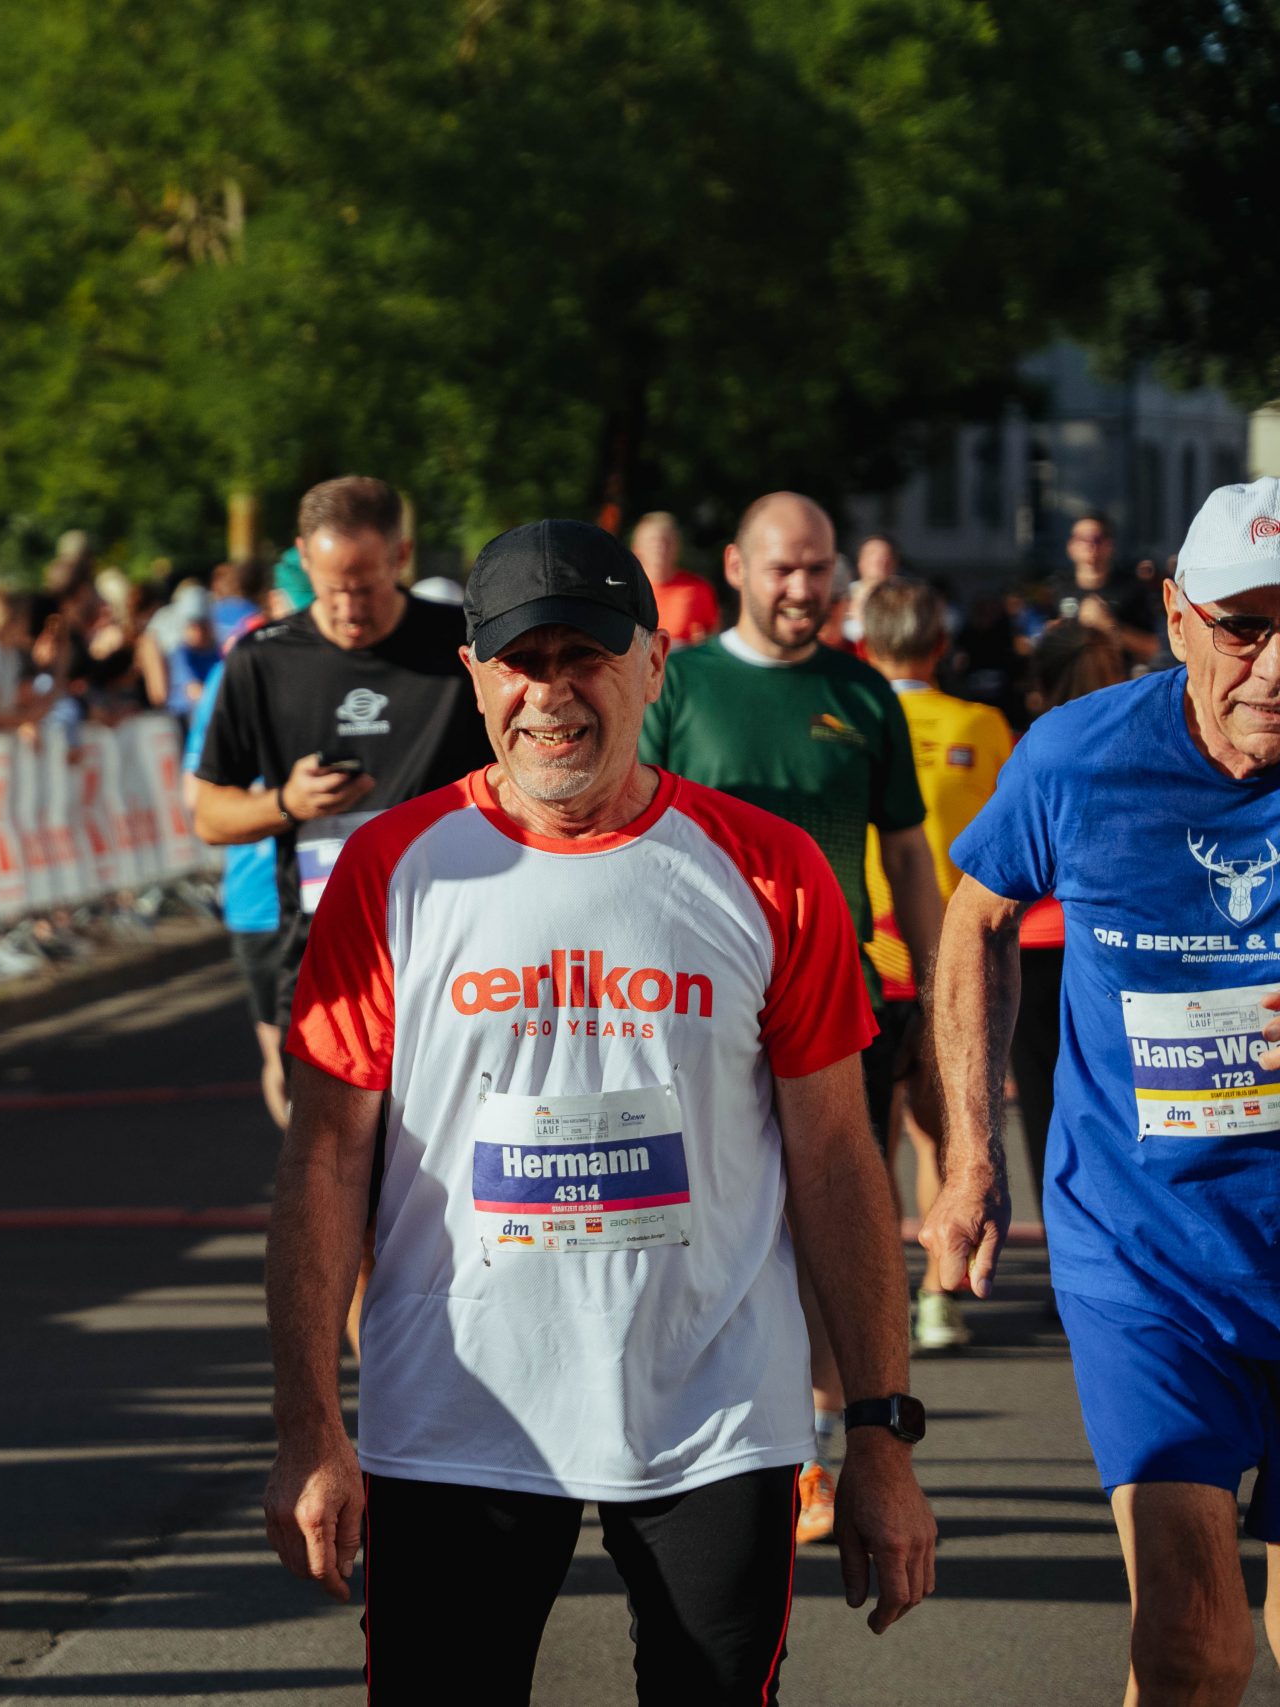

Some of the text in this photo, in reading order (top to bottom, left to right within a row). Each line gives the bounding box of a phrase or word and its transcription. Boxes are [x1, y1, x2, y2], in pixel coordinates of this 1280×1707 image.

[1093, 927, 1128, 948] DR.
[1136, 933, 1239, 951] BENZEL
[1246, 934, 1267, 949] &
[511, 1020, 654, 1039] 150 YEARS
[1190, 1019, 1211, 1027] LAUF
[1211, 1070, 1255, 1089] 1723
[1167, 1106, 1191, 1121] dm
[537, 1126, 560, 1134] LAUF
[502, 1146, 650, 1178] Hermann
[554, 1184, 600, 1202] 4314
[502, 1219, 530, 1236] dm
[610, 1214, 665, 1227] BIONTECH
